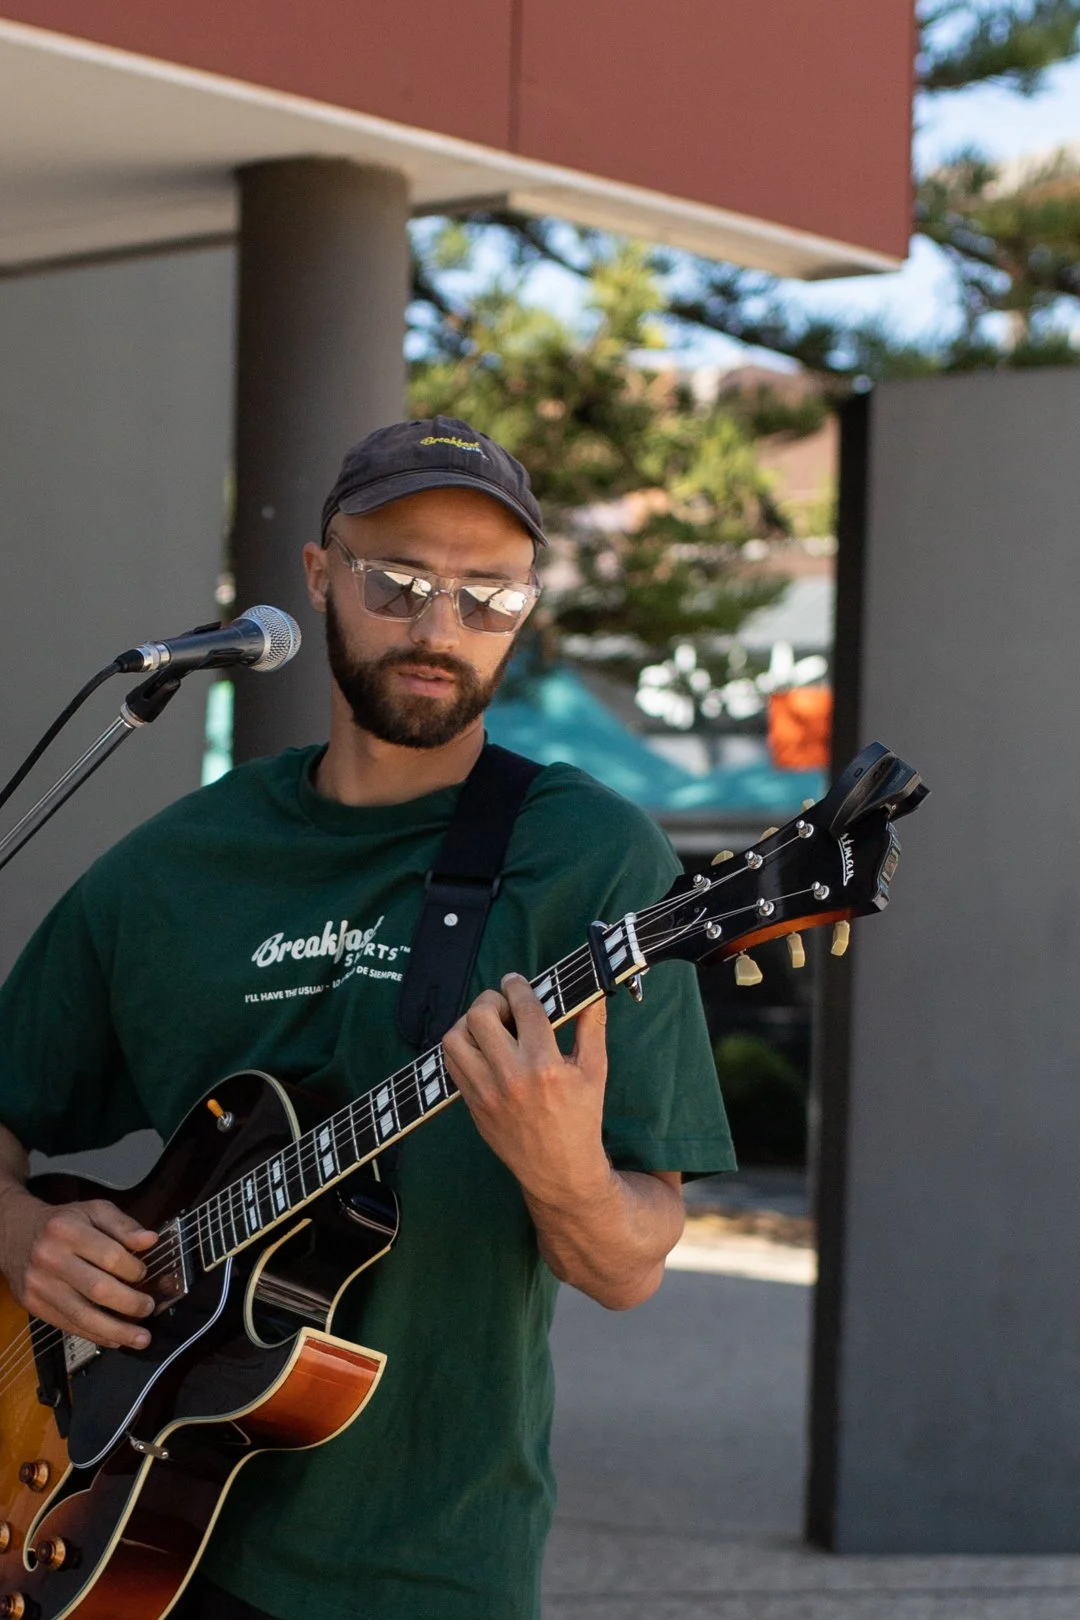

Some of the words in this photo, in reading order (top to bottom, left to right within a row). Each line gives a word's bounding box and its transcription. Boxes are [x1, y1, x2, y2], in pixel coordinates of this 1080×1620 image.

[420, 436, 479, 448] Breakfast
[244, 993, 260, 1003] I'LL
[260, 990, 284, 1001] HAVE
[356, 965, 369, 975] DE
[369, 968, 403, 982] SIEMPRE
